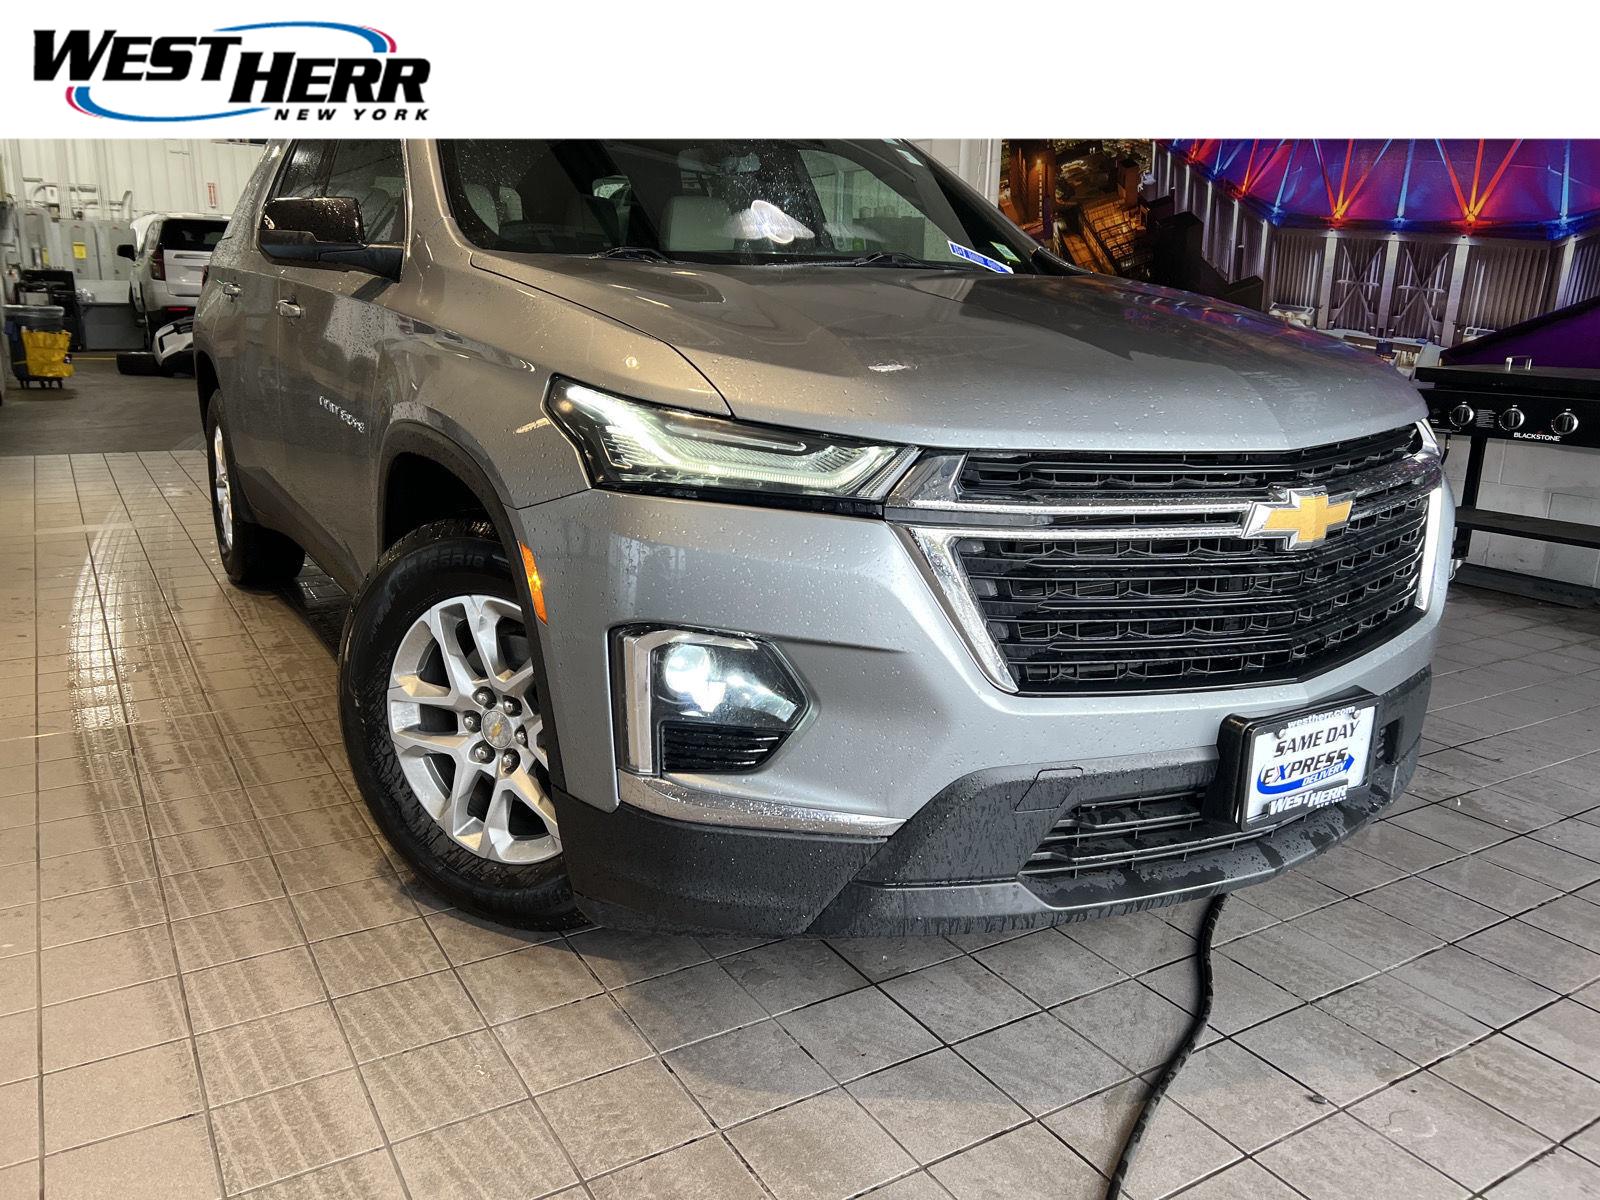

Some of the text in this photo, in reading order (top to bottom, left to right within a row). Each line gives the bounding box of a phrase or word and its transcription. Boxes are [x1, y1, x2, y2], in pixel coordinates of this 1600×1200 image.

[1513, 432, 1561, 442] BLACKSTONE
[1274, 720, 1360, 758] SAME DAY
[1263, 747, 1348, 785] EXPRESS
[1302, 761, 1347, 787] DELIVERY
